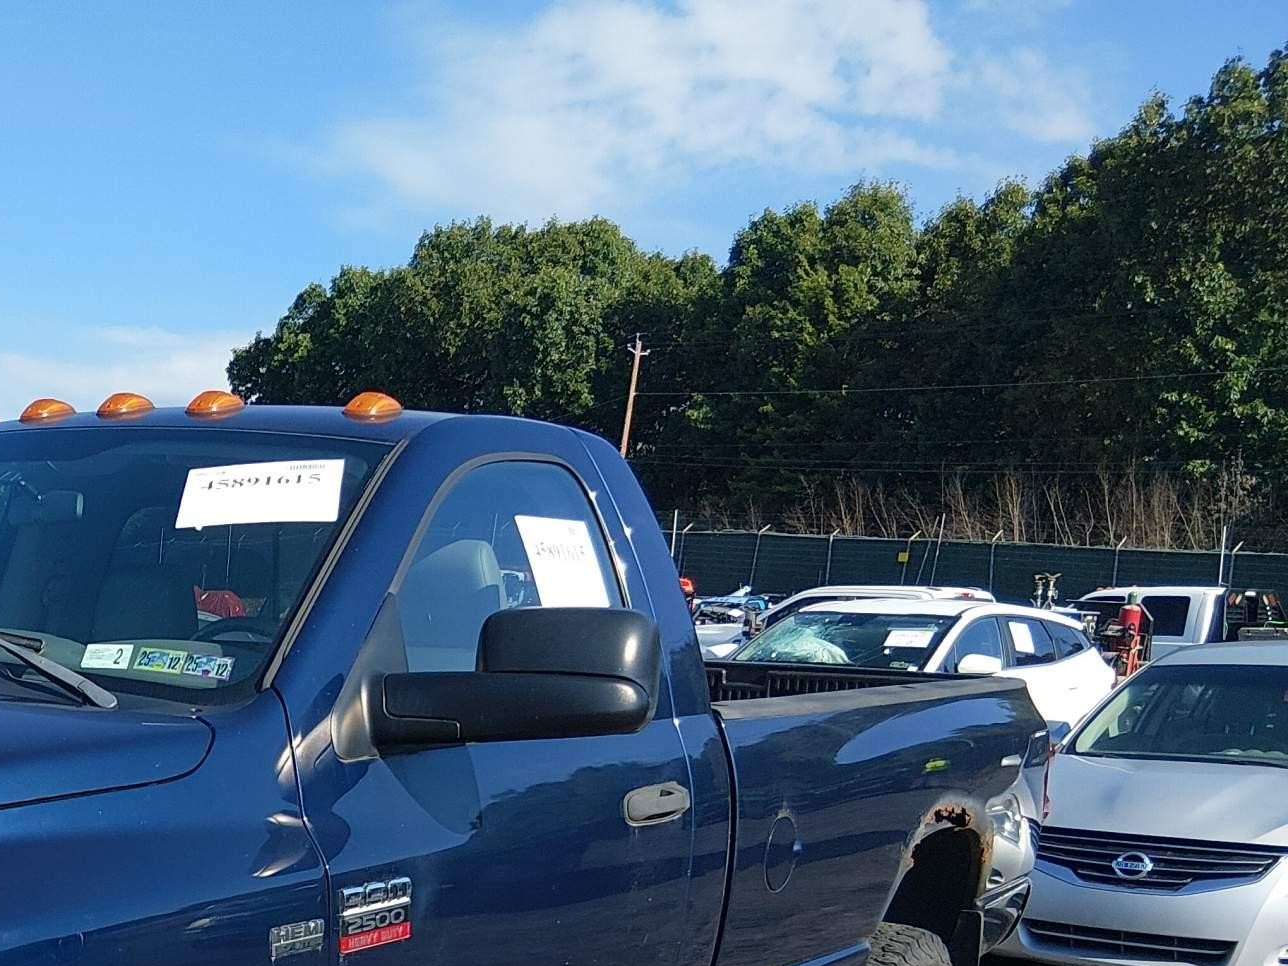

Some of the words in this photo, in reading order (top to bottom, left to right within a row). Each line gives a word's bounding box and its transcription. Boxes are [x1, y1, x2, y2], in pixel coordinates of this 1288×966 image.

[200, 473, 321, 490] 45891615
[113, 648, 123, 665] 2
[138, 651, 152, 667] 25
[167, 656, 181, 670] 12
[185, 655, 199, 673] 25
[215, 662, 229, 677] 12
[270, 918, 325, 943] HEMI
[348, 908, 405, 934] 2500
